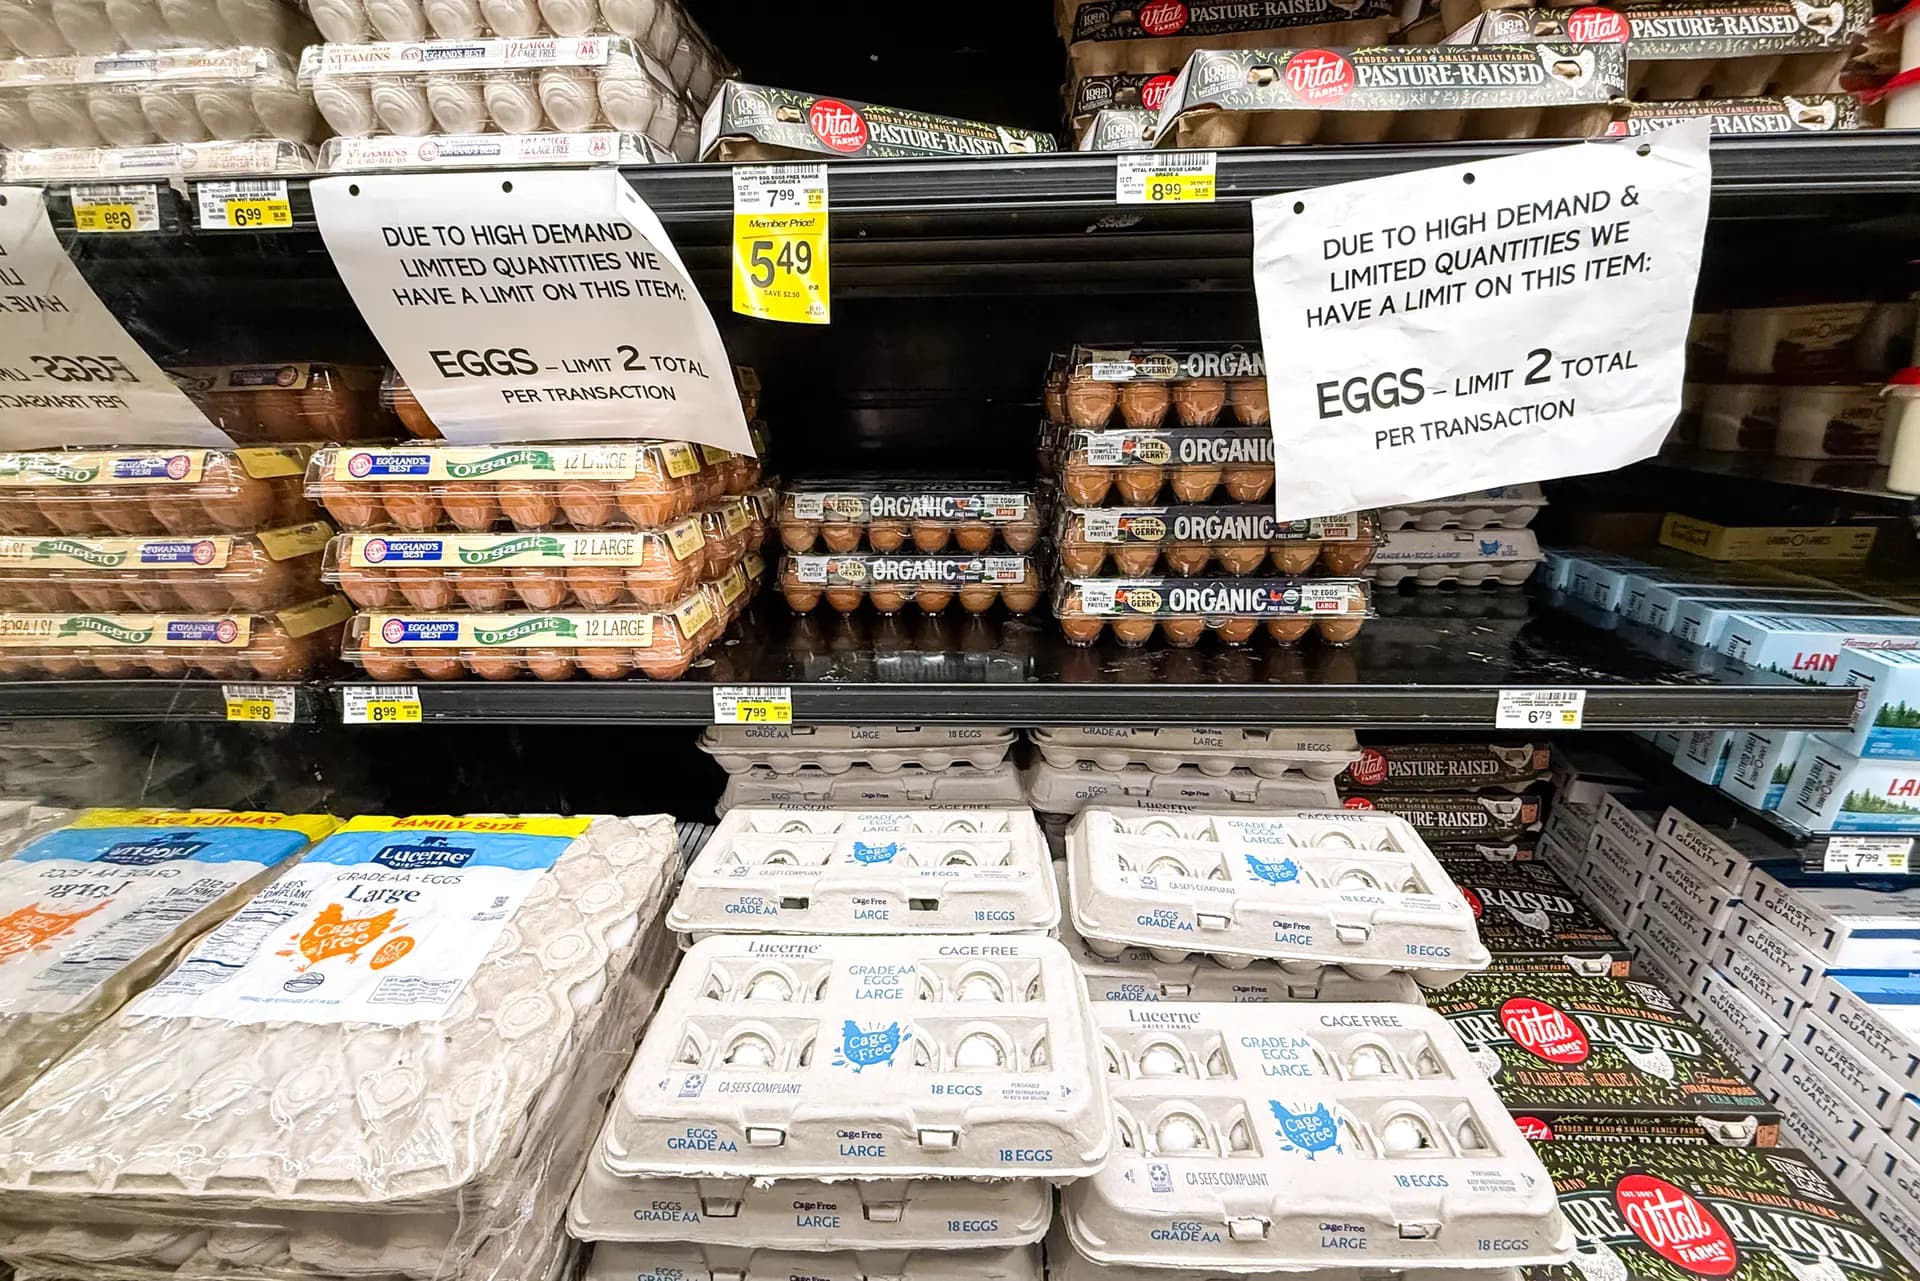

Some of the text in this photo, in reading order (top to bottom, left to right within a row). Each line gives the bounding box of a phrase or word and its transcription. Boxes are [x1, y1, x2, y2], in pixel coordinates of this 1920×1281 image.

[1190, 0, 1327, 22] PASTURE-RAISED
[1570, 13, 1621, 42] Vital
[1630, 14, 1799, 38] PASTURE-RAISED
[1356, 63, 1545, 88] PASTURE-RAISED
[812, 109, 860, 145] Vital FARMS
[767, 190, 794, 207] 799
[749, 218, 815, 228] Member Price!
[1323, 184, 1640, 260] DUE TO HIGH DEMAND &
[382, 222, 633, 247] DUE TO HIGH DEMAND
[400, 250, 661, 278] LIMITED QUANTITIES WE
[750, 240, 812, 288] 549
[1330, 221, 1630, 292] LIMITED QUANTITIES WE
[393, 278, 686, 306] HAVE A LIMIT ON THIS ITEM:
[1306, 253, 1652, 328] HAVE A LIMIT ON THIS ITEM:
[429, 344, 709, 379] EGGS LIMIT 2 TOTAL
[1187, 352, 1267, 377] ORGAN
[1316, 347, 1638, 420] EGGS LIMIT 2 TOTAL
[501, 384, 676, 403] PER TRANSACTION
[1375, 398, 1575, 450] PER TRANSACTION
[452, 450, 536, 478] Organic
[870, 494, 954, 519] ORGANIC
[1174, 516, 1274, 539] ORGANIC
[402, 550, 425, 559] BEST
[465, 536, 545, 564] Organic
[573, 538, 634, 556] 12 LARGE
[1169, 588, 1266, 612] ORGANIC
[420, 631, 443, 640] BEST
[480, 618, 560, 646] Organic
[585, 619, 645, 637] 12 LARGE
[1792, 653, 1839, 672] LAN
[373, 707, 396, 720] 899
[743, 708, 766, 721] 799
[1528, 710, 1552, 723] 679
[1388, 760, 1498, 776] PASTURE-RAISED
[393, 818, 527, 830] FAMILY SIZE
[379, 847, 470, 863] Lucerne
[1855, 854, 1879, 867] 799
[1255, 861, 1287, 873] Cage
[344, 884, 421, 903] Large
[1474, 887, 1574, 914] RAISED
[725, 905, 778, 916] GRADE AA
[854, 909, 889, 920] LARGE
[974, 911, 1015, 921] 18 EGGS
[1764, 898, 1816, 937] QUALITY
[1776, 896, 1812, 924] FIRST
[747, 941, 1018, 956] Lucerne CAGE FREE
[1406, 944, 1451, 957] 18 EGGS
[1128, 1009, 1402, 1028] Lucerne CAGE FREE
[1576, 1014, 1701, 1056] RAISED
[1839, 1014, 1898, 1061] QUALITY
[1852, 1013, 1892, 1044] FIRST
[850, 1031, 888, 1050] Cage
[859, 1042, 893, 1062] Free
[1262, 1048, 1300, 1060] EGGS
[718, 1081, 730, 1092] CA
[752, 1082, 802, 1094] COMPLIANT
[1528, 1072, 1562, 1086] LARGE
[1285, 1115, 1322, 1133] Cage
[836, 1130, 883, 1140] Cage Free
[1300, 1125, 1334, 1147] Free
[840, 1144, 886, 1158] LARGE
[651, 1201, 681, 1212] EGGS
[1707, 1184, 1839, 1220] SMALL FAMILY FARMS
[1171, 1222, 1202, 1232] EGGS
[1319, 1222, 1365, 1233] Cage Free
[1628, 1188, 1726, 1264] Vital FARMS
[1151, 1229, 1221, 1243] GRADE AA
[1321, 1236, 1367, 1250] LARGE
[1477, 1239, 1529, 1251] 18 EGGS
[1712, 1202, 1883, 1270] RAISED
